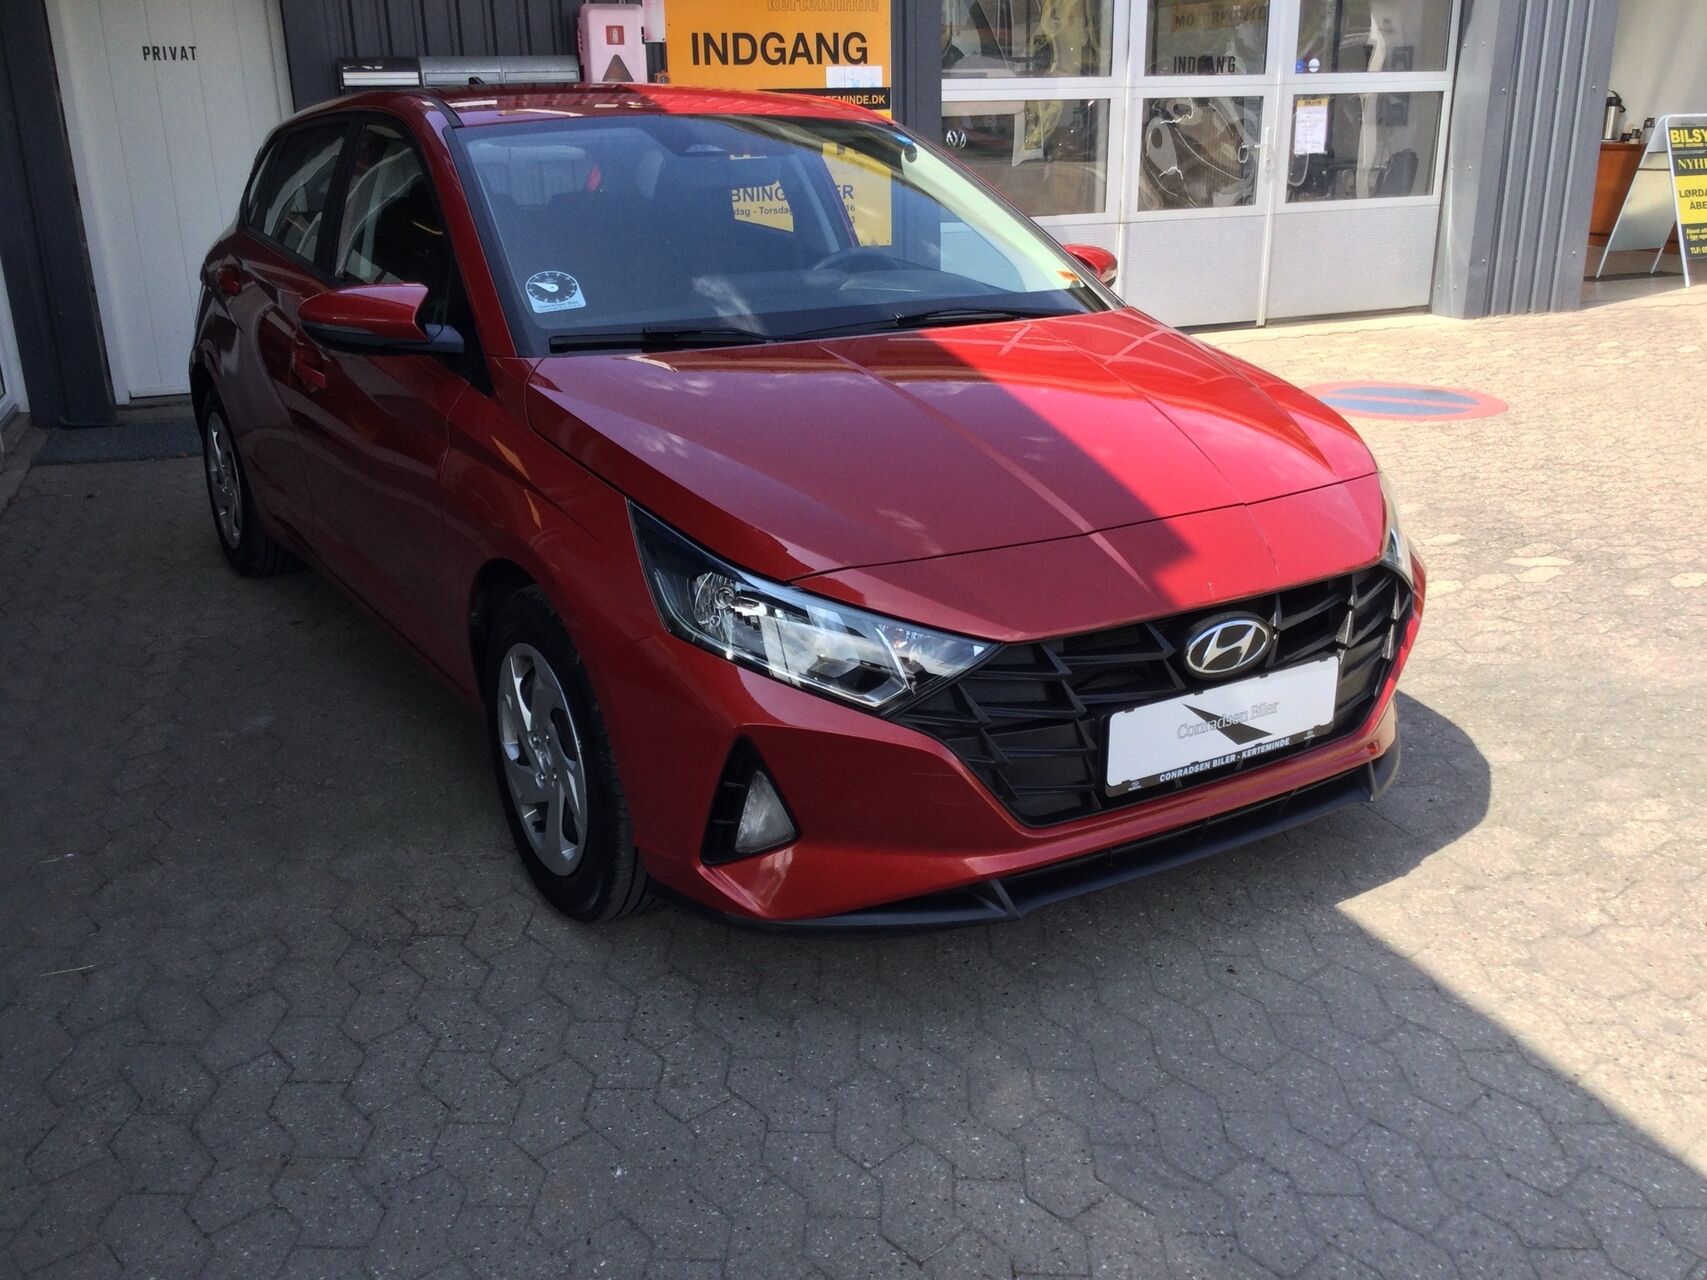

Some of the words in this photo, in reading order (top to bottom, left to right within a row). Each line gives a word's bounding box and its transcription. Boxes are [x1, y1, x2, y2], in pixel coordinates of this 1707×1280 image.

[142, 46, 197, 61] PRIVAT
[691, 31, 868, 65] INDGANG
[828, 94, 886, 105] MINDE.DK
[1177, 710, 1248, 739] Conradsen
[1250, 701, 1281, 720] Biler
[1159, 761, 1211, 783] CONRADSEN
[1212, 753, 1236, 769] BILER
[1242, 737, 1290, 758] KERTEMINDE
